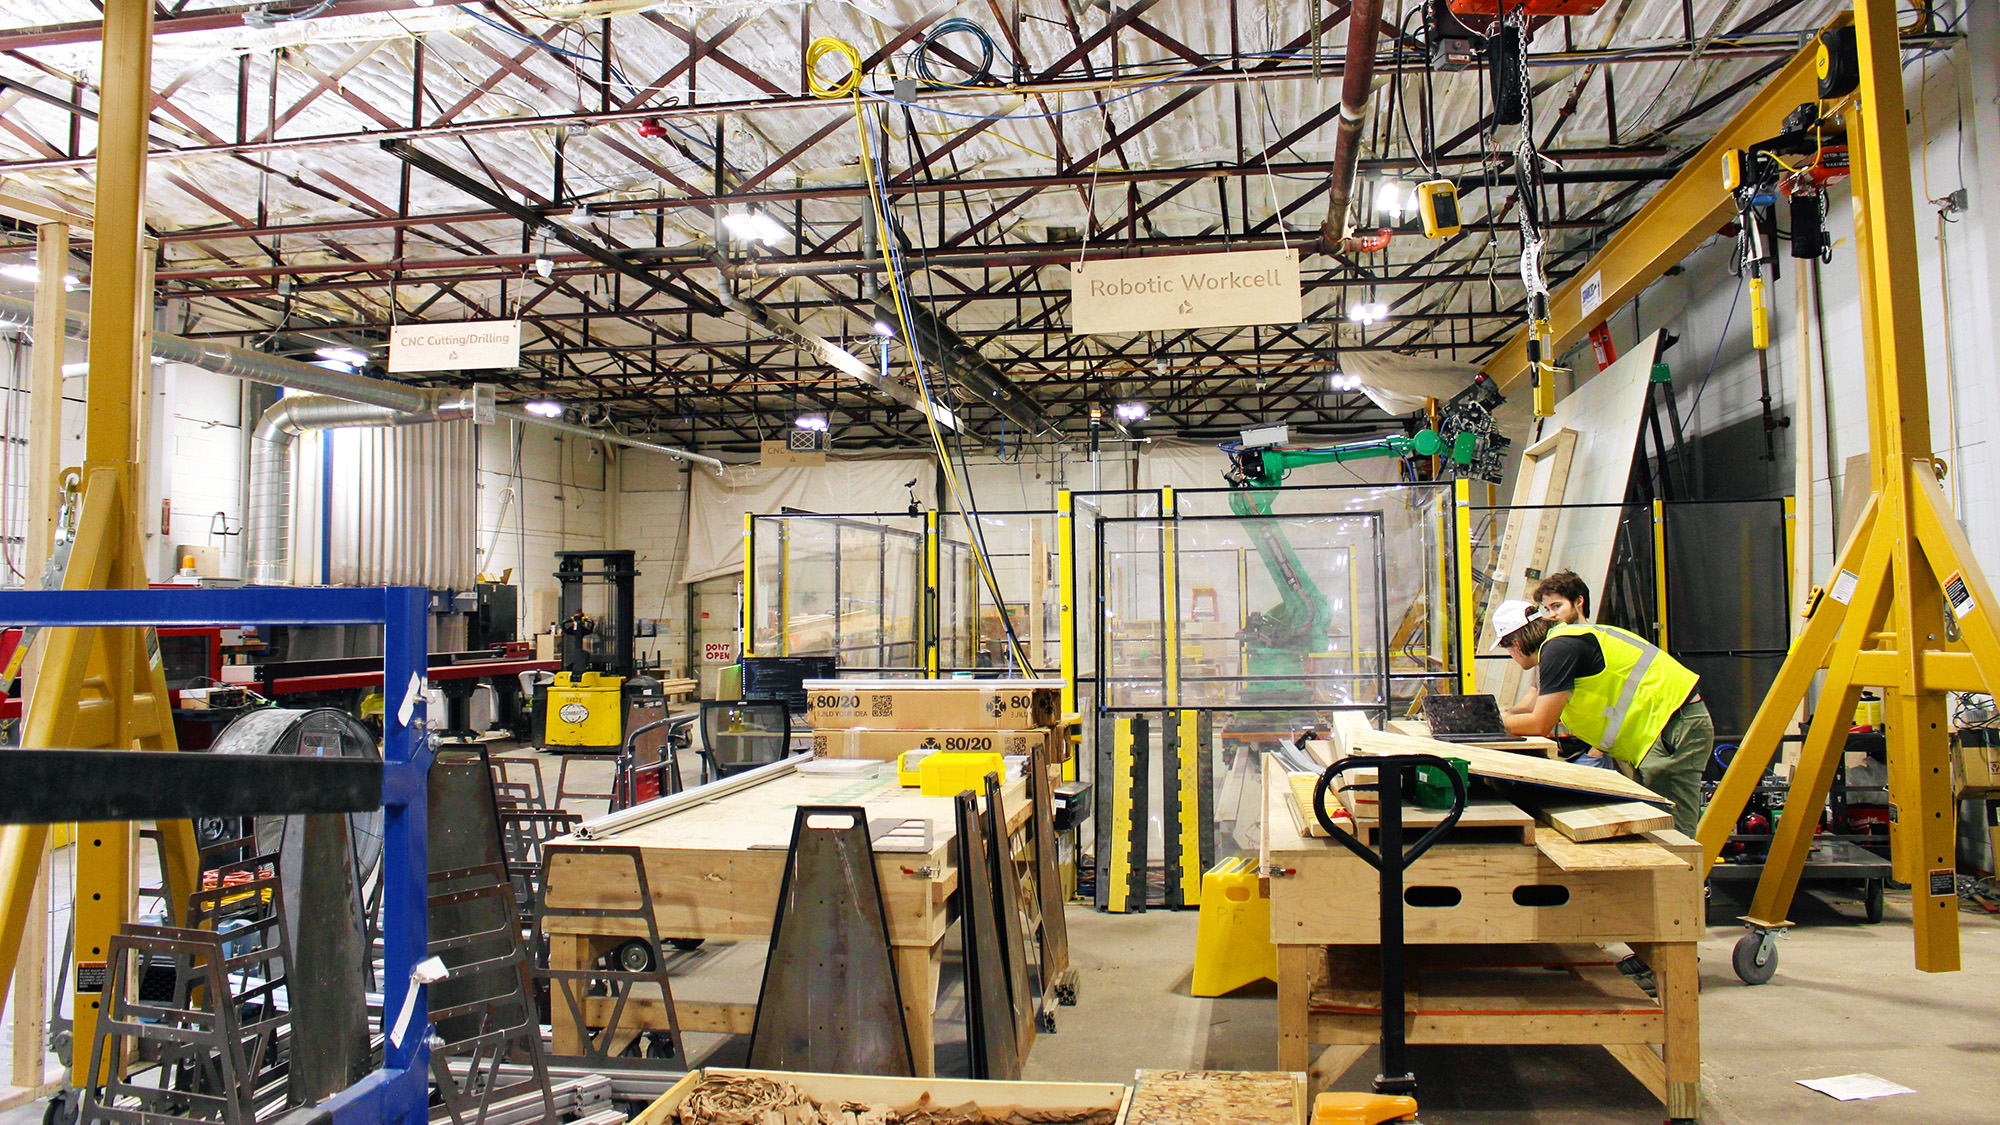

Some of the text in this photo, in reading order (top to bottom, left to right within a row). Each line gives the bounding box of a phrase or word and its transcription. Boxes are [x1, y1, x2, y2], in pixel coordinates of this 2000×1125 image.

[1090, 269, 1282, 297] Robotic Workcell
[400, 334, 510, 347] CNC Cutting/Drilling
[767, 447, 785, 455] CNC
[705, 651, 730, 660] OPEN
[816, 695, 860, 708] 80/20
[945, 737, 992, 750] 80/20
